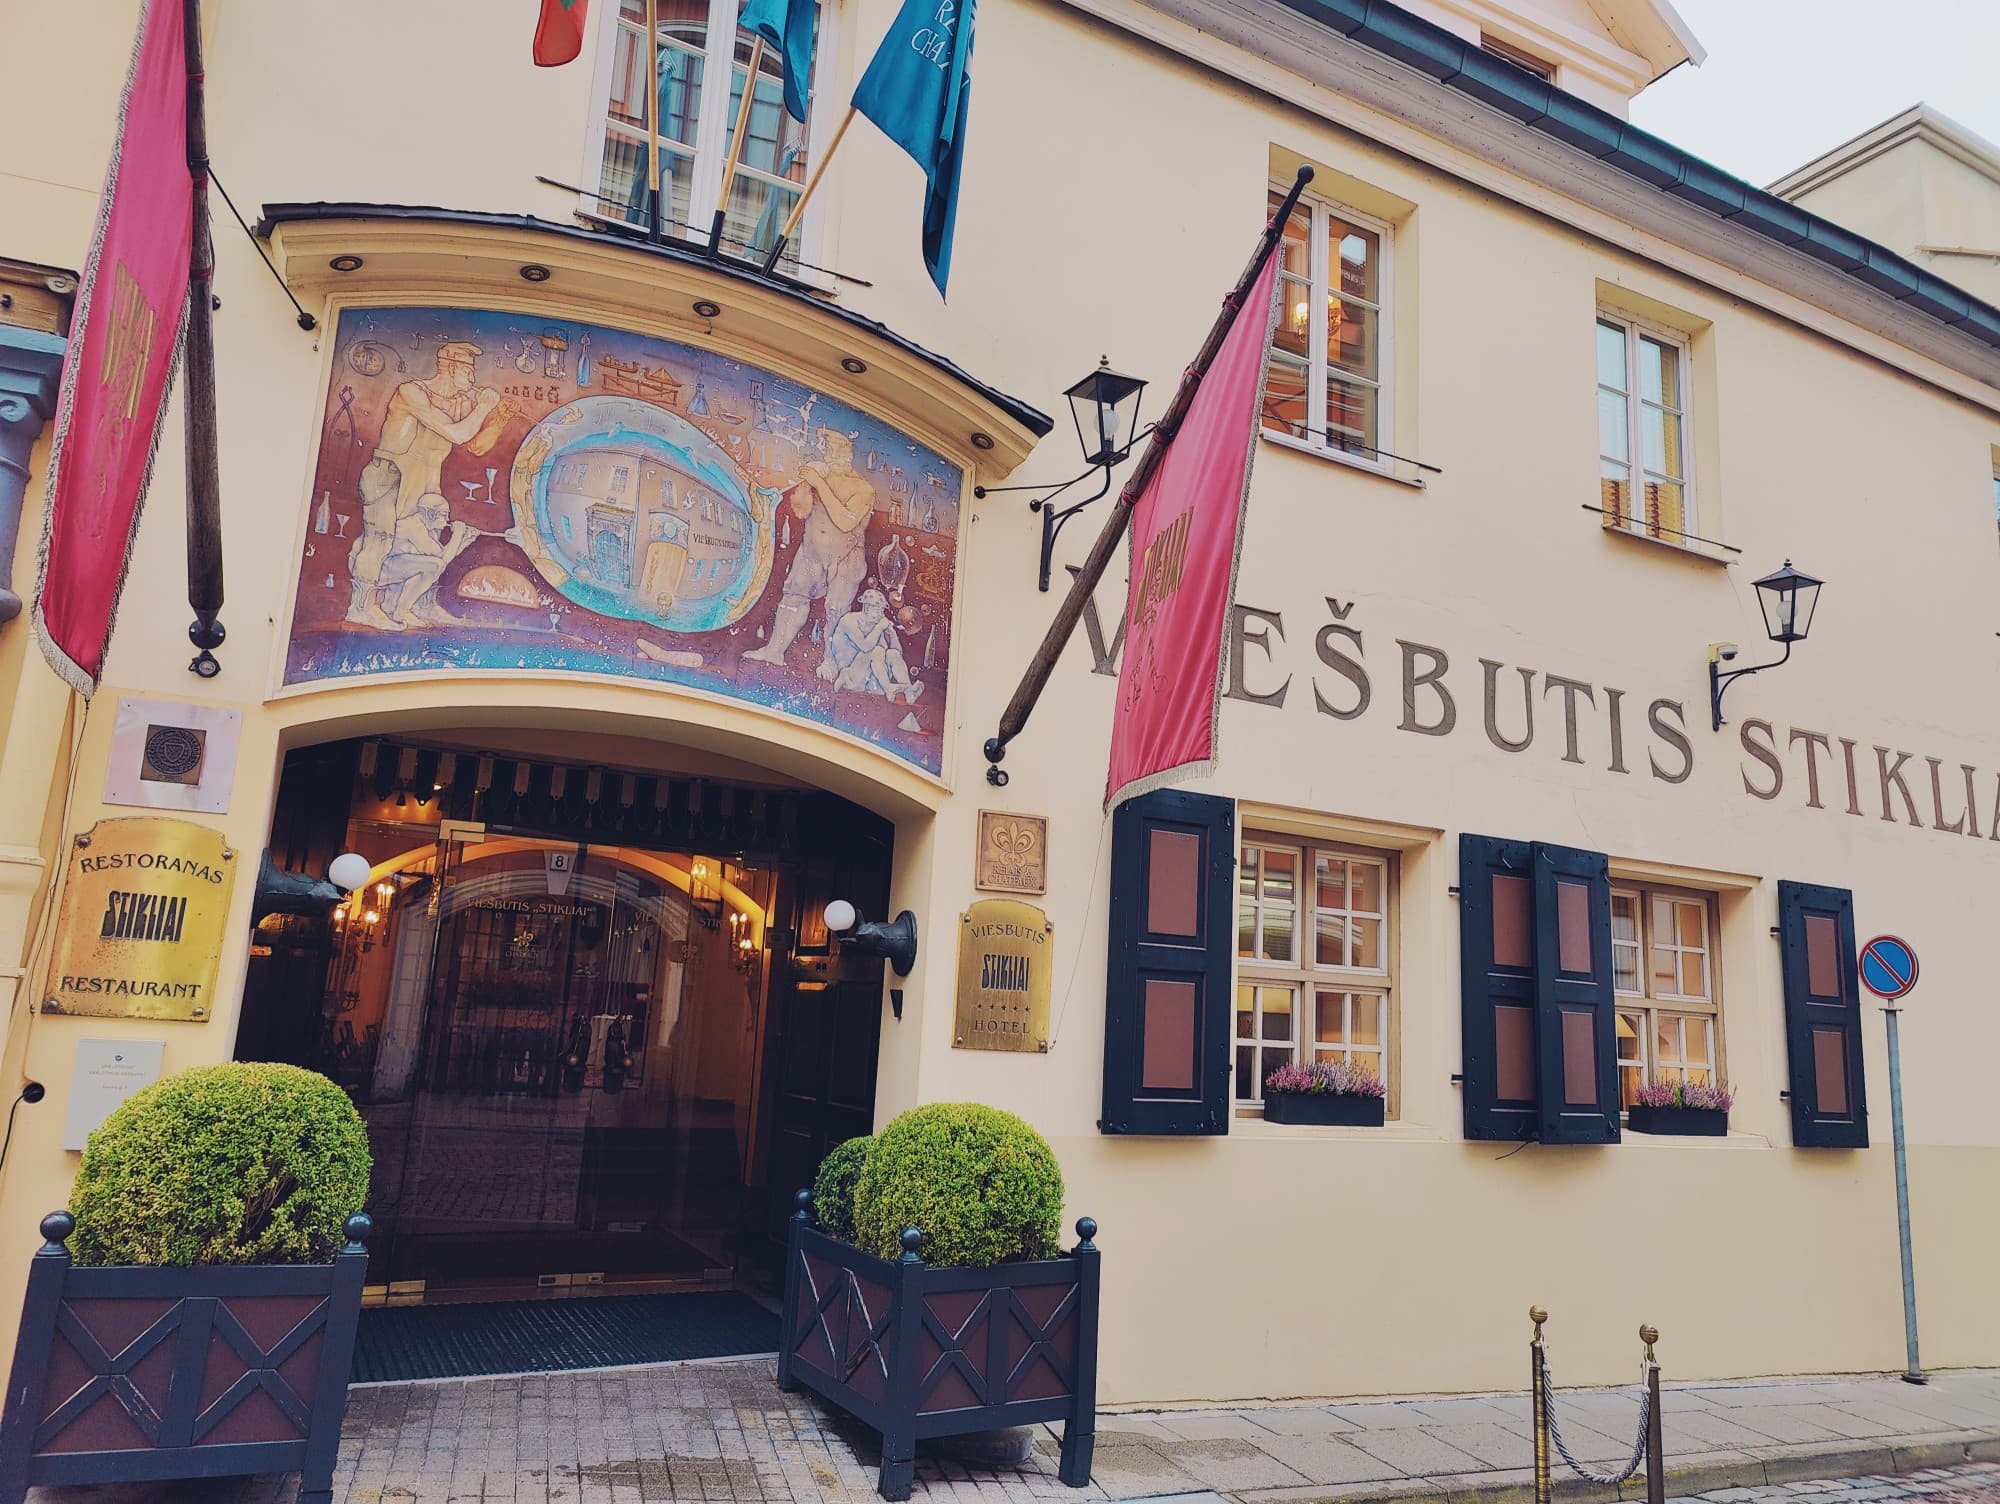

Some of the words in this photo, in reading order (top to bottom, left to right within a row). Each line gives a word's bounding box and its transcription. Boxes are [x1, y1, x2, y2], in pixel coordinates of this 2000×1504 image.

[911, 28, 950, 71] CHA
[1064, 564, 1694, 785] VEŠBUTIS
[80, 853, 224, 884] RESTORANAS
[555, 855, 564, 868] 8
[101, 890, 187, 942] STIKLIAI
[971, 923, 1045, 945] VIESBUTIS
[60, 976, 201, 999] RESTAURANT
[981, 953, 1030, 992] STIKLIAI
[974, 1019, 1031, 1034] HOTEL
